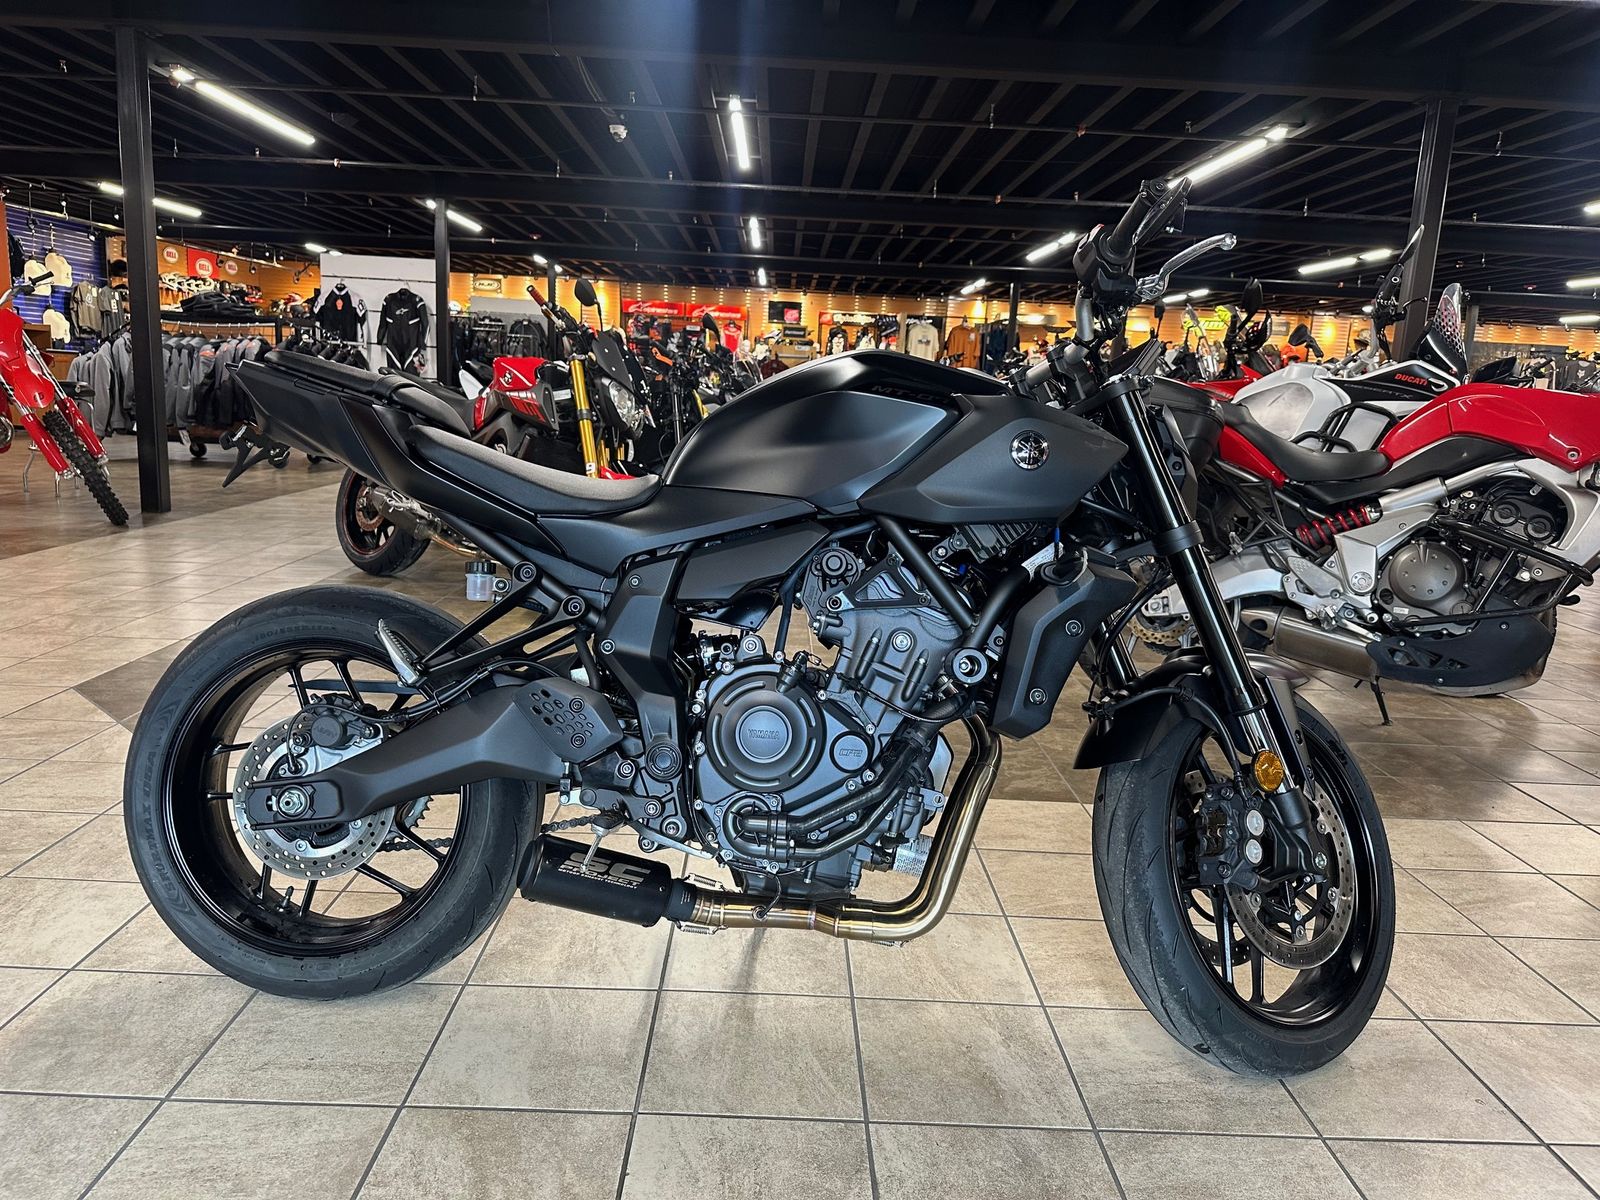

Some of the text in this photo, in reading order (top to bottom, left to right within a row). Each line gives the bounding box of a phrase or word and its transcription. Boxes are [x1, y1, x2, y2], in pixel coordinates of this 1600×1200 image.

[165, 250, 177, 259] BELL
[198, 262, 210, 272] BELL
[1393, 373, 1428, 386] DUCATI
[748, 728, 781, 741] YAMAHA
[563, 852, 651, 882] SC
